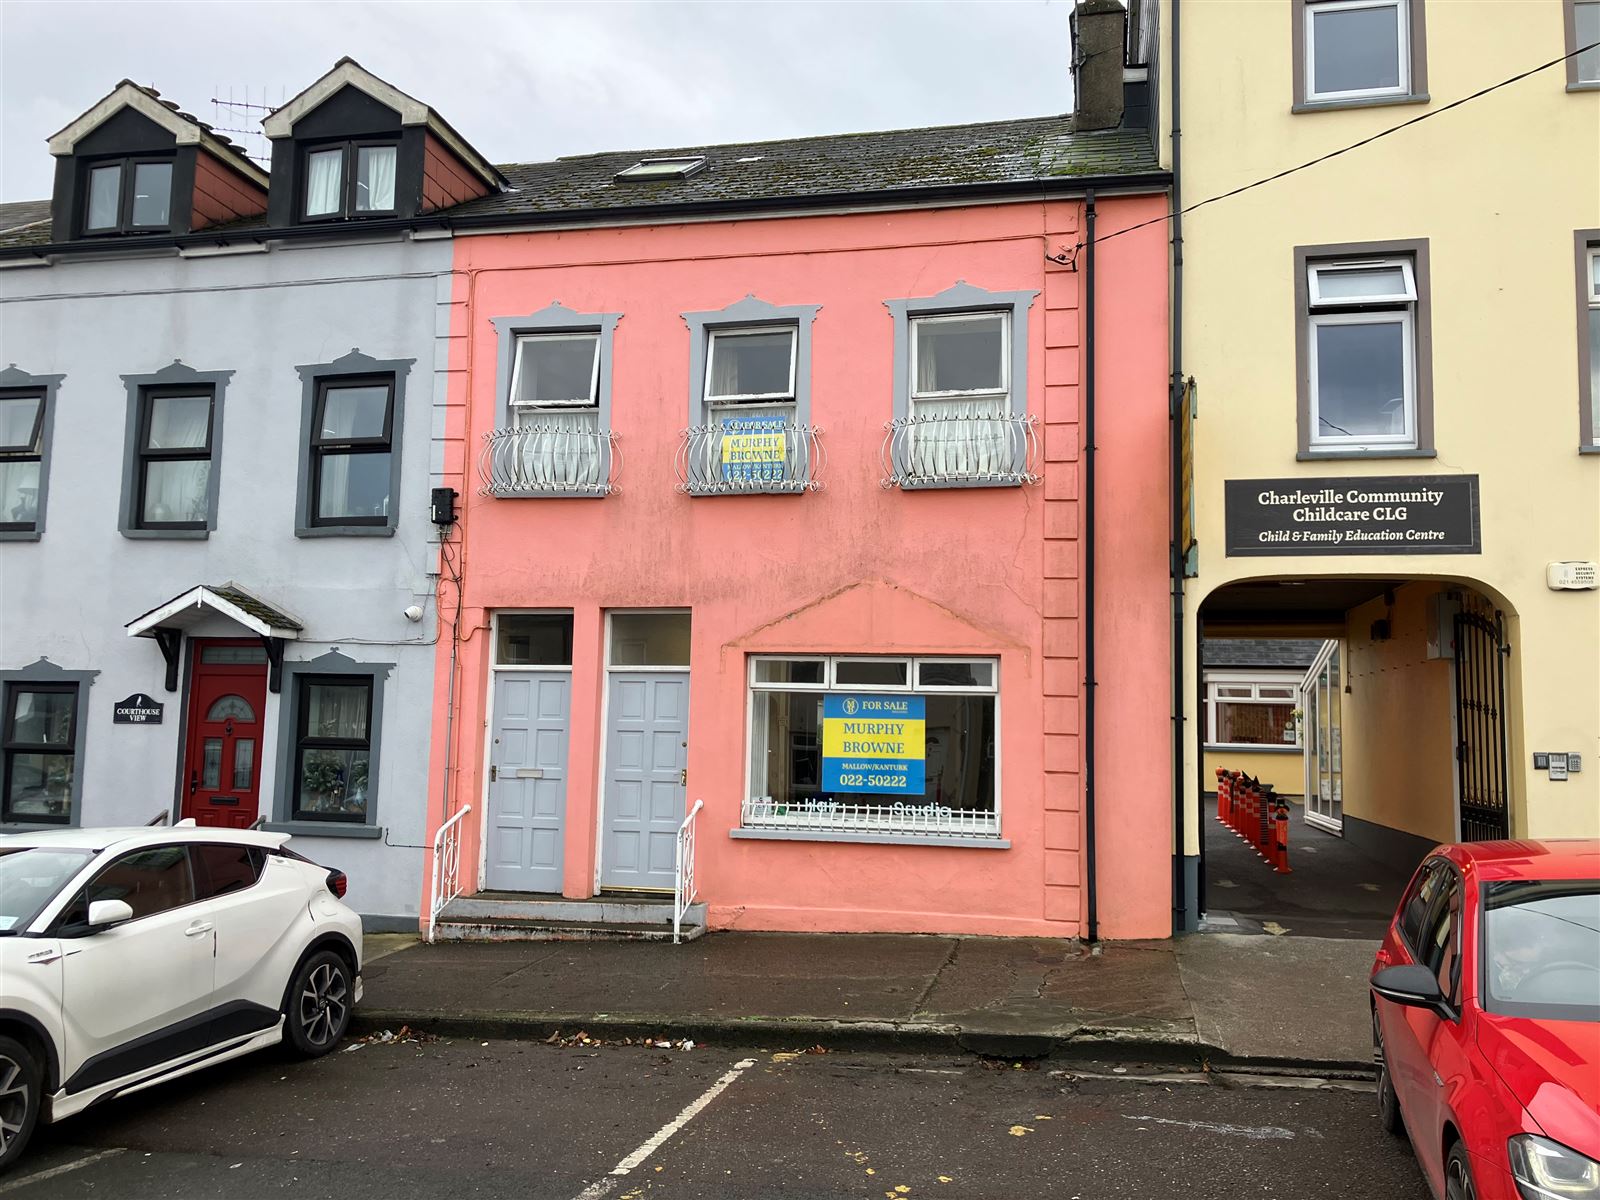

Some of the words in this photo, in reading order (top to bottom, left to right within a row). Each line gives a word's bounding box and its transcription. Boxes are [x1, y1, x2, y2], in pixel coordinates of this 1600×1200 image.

[730, 437, 780, 448] MURPHY
[730, 449, 780, 461] BROWNE
[1258, 489, 1344, 506] Charleville
[1346, 488, 1444, 506] Community
[1292, 508, 1370, 522] Childcare
[1373, 507, 1408, 521] CLG
[1259, 530, 1290, 542] Child
[1292, 531, 1302, 542] &
[1302, 530, 1343, 544] Family
[1345, 529, 1403, 542] Education
[1405, 529, 1445, 541] Centre
[116, 707, 161, 716] COURTHOUSE
[862, 701, 882, 710] FOR
[883, 701, 908, 711] SALE
[129, 714, 147, 722] VIEW
[843, 722, 905, 736] MURPHY
[843, 741, 905, 754] BROWNE
[842, 763, 908, 771] MALLOW/KANTURK
[840, 774, 907, 787] 022-50222
